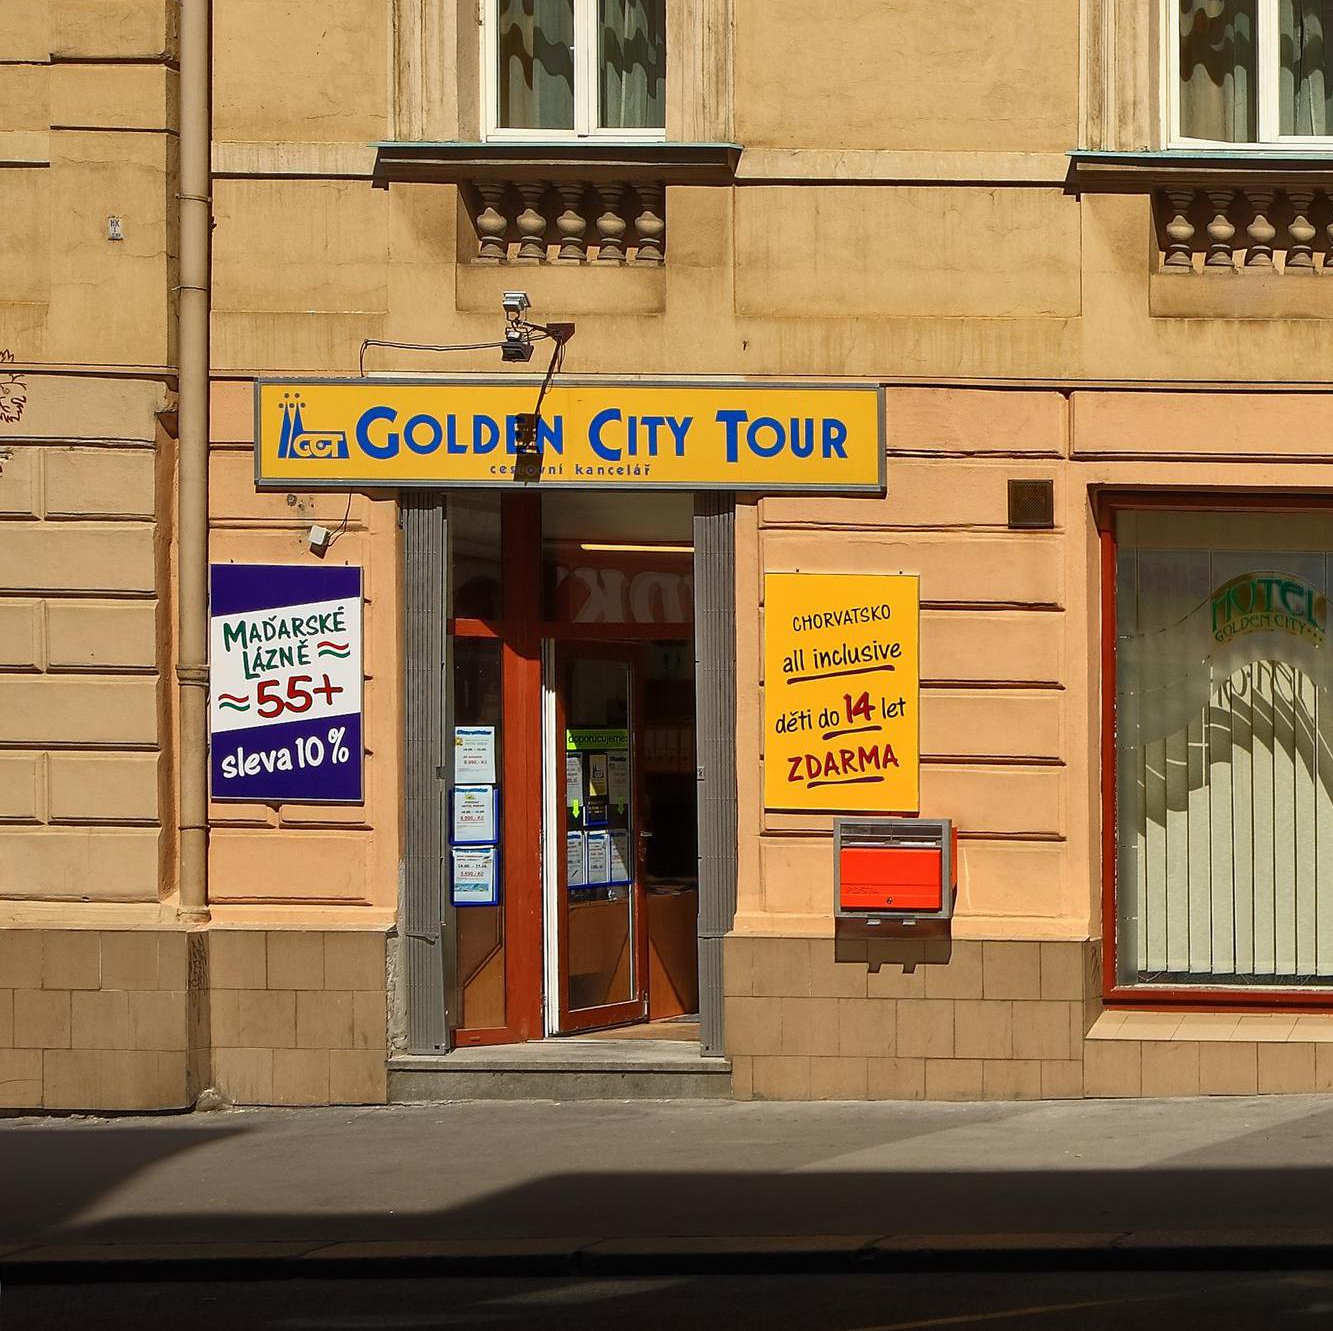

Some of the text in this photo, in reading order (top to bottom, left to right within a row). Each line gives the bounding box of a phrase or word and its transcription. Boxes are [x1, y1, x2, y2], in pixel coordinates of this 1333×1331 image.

[588, 408, 694, 462] CITY
[715, 409, 849, 463] TOUR
[575, 463, 651, 476] kancelář
[792, 604, 891, 632] CHORVATSKO
[1211, 577, 1325, 634] HOTEL
[223, 606, 347, 652] MAĎARSKÉ
[1215, 614, 1306, 642] GOLDEN CITY
[242, 639, 312, 680] LÁZNĚ
[783, 640, 902, 673] all inclusive
[256, 673, 343, 718] 55+
[775, 691, 906, 733] děti do 14 let
[221, 746, 293, 779] sleva
[787, 743, 900, 782] ZDARMA
